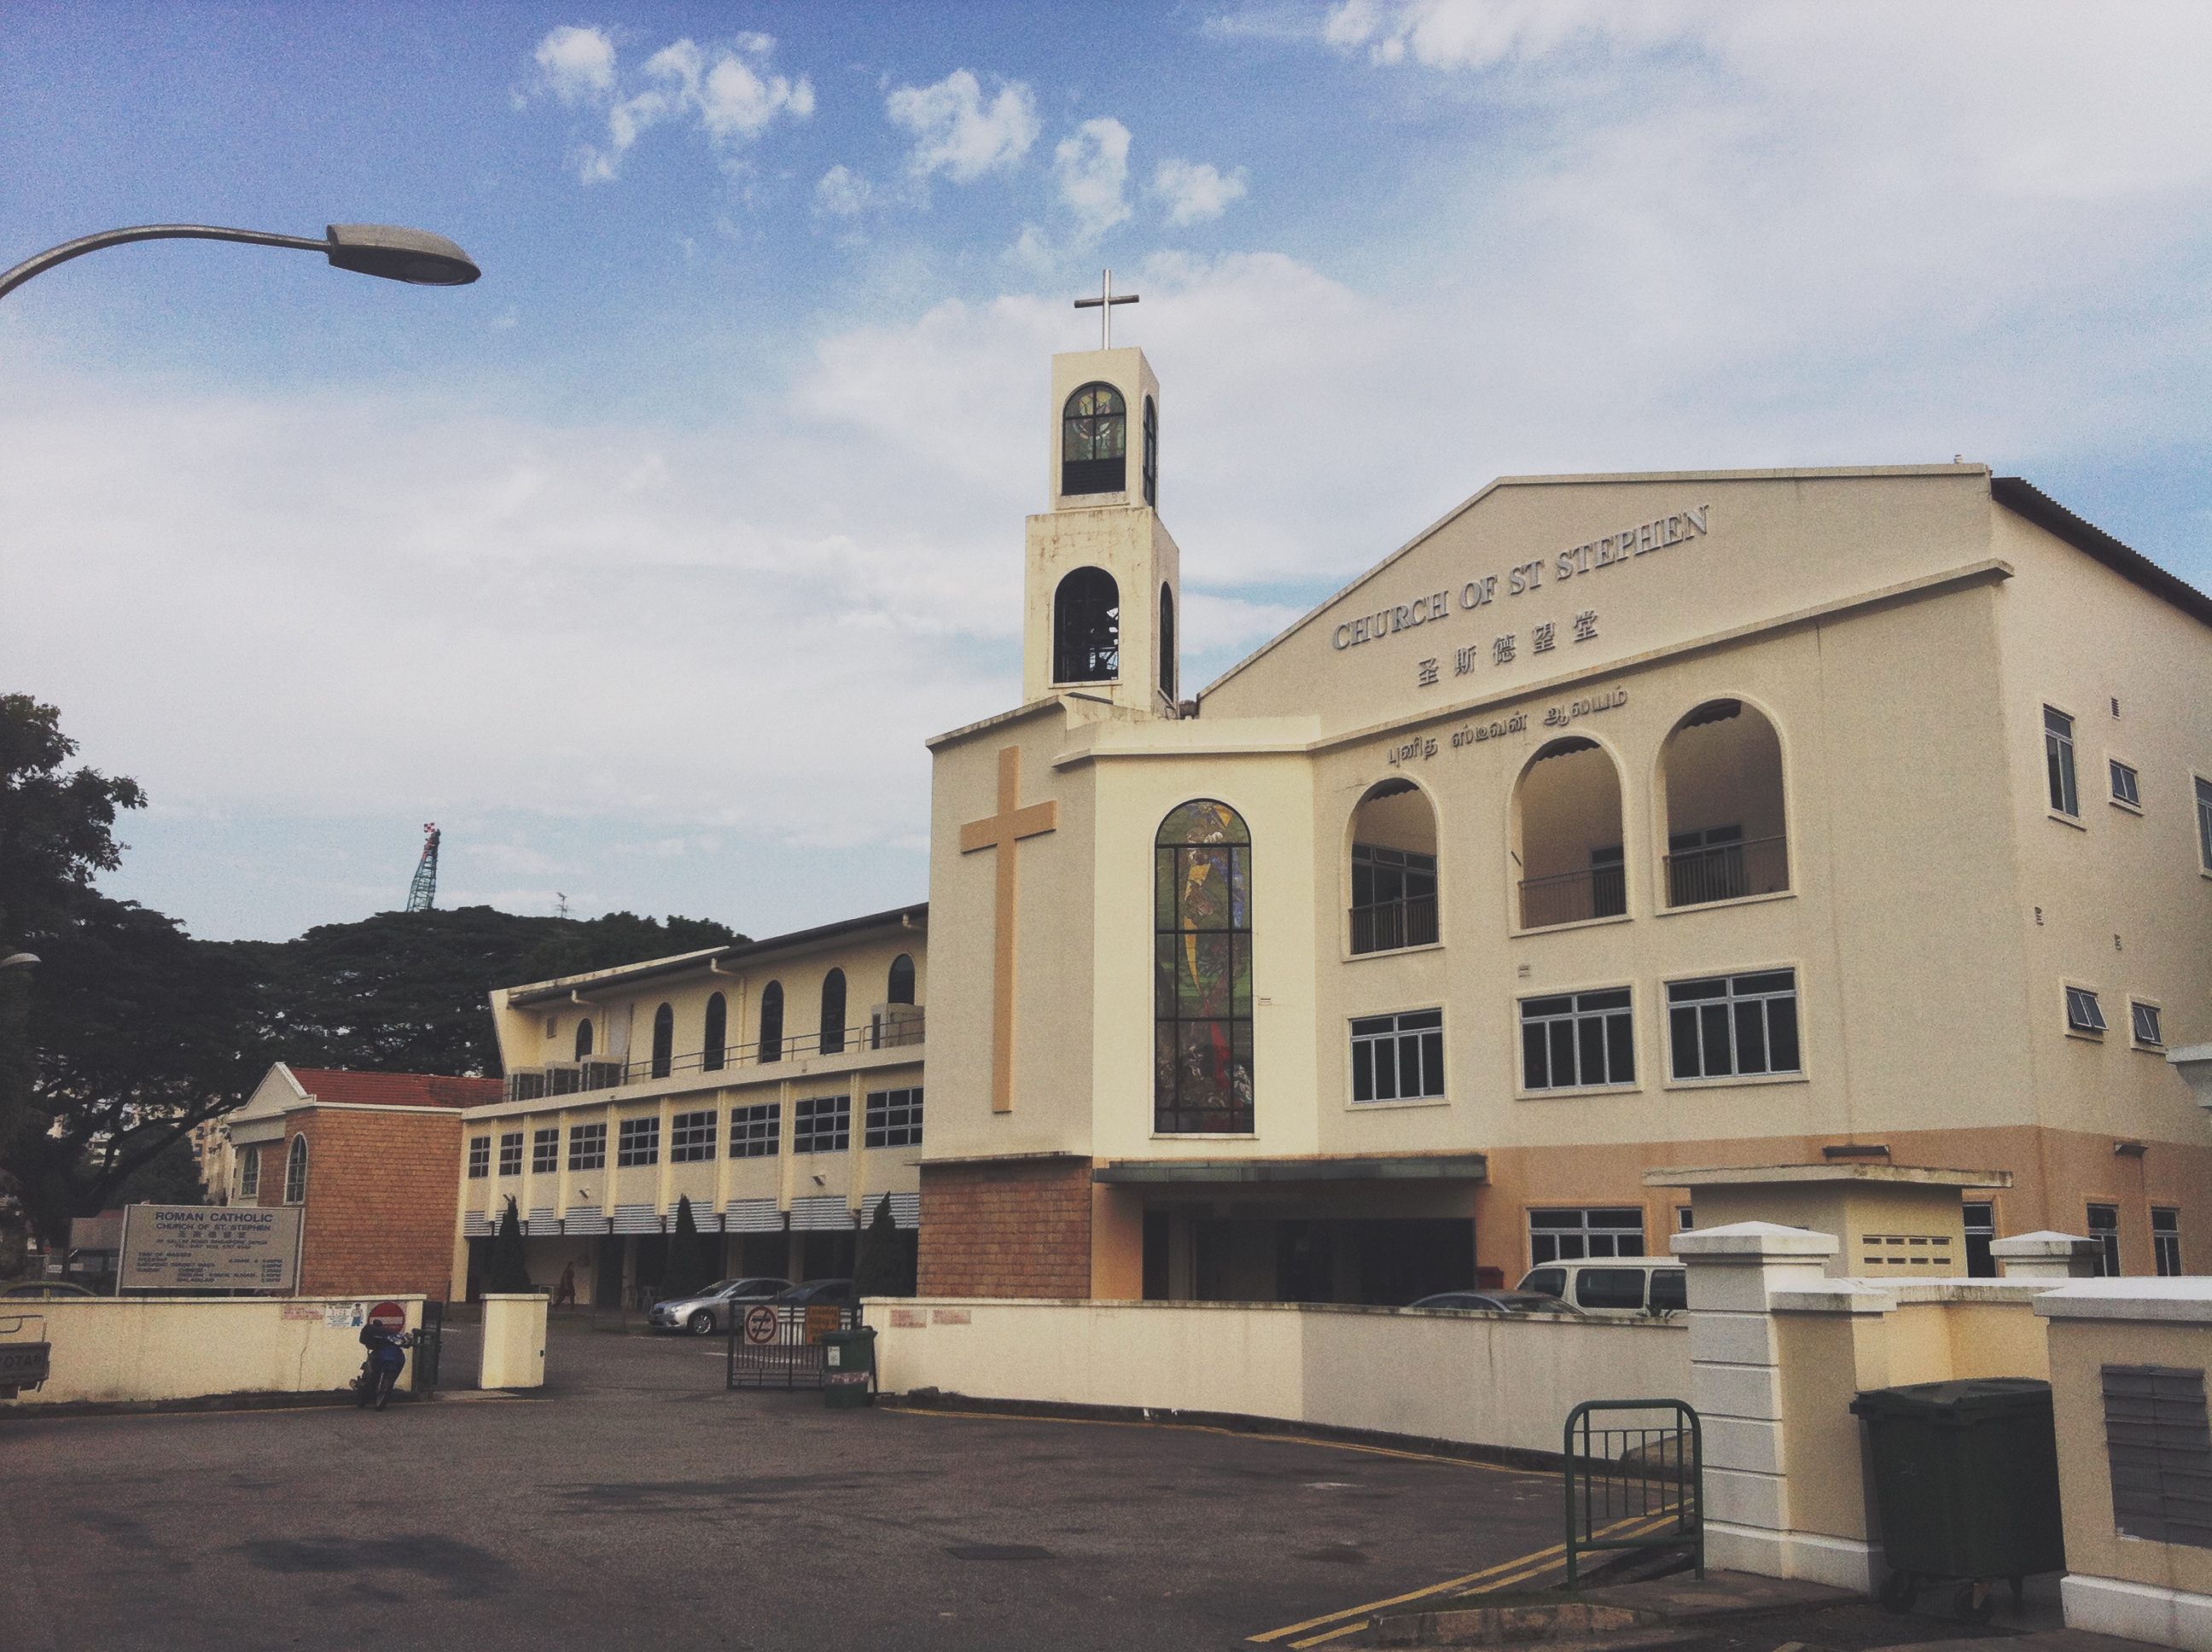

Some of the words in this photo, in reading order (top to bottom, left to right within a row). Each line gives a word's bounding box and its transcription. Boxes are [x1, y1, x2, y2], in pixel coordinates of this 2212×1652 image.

[1332, 590, 1450, 650] CHURCH
[1459, 574, 1498, 610] OF
[1509, 559, 1545, 596] ST
[1557, 505, 1709, 580] STEPHEN
[1418, 610, 1598, 688] 圣斯德望堂
[1388, 735, 1438, 765] புனித
[1543, 684, 1627, 725] ஆலயம்
[155, 1212, 204, 1221] ROMAN
[210, 1213, 274, 1223] CATHOLIC
